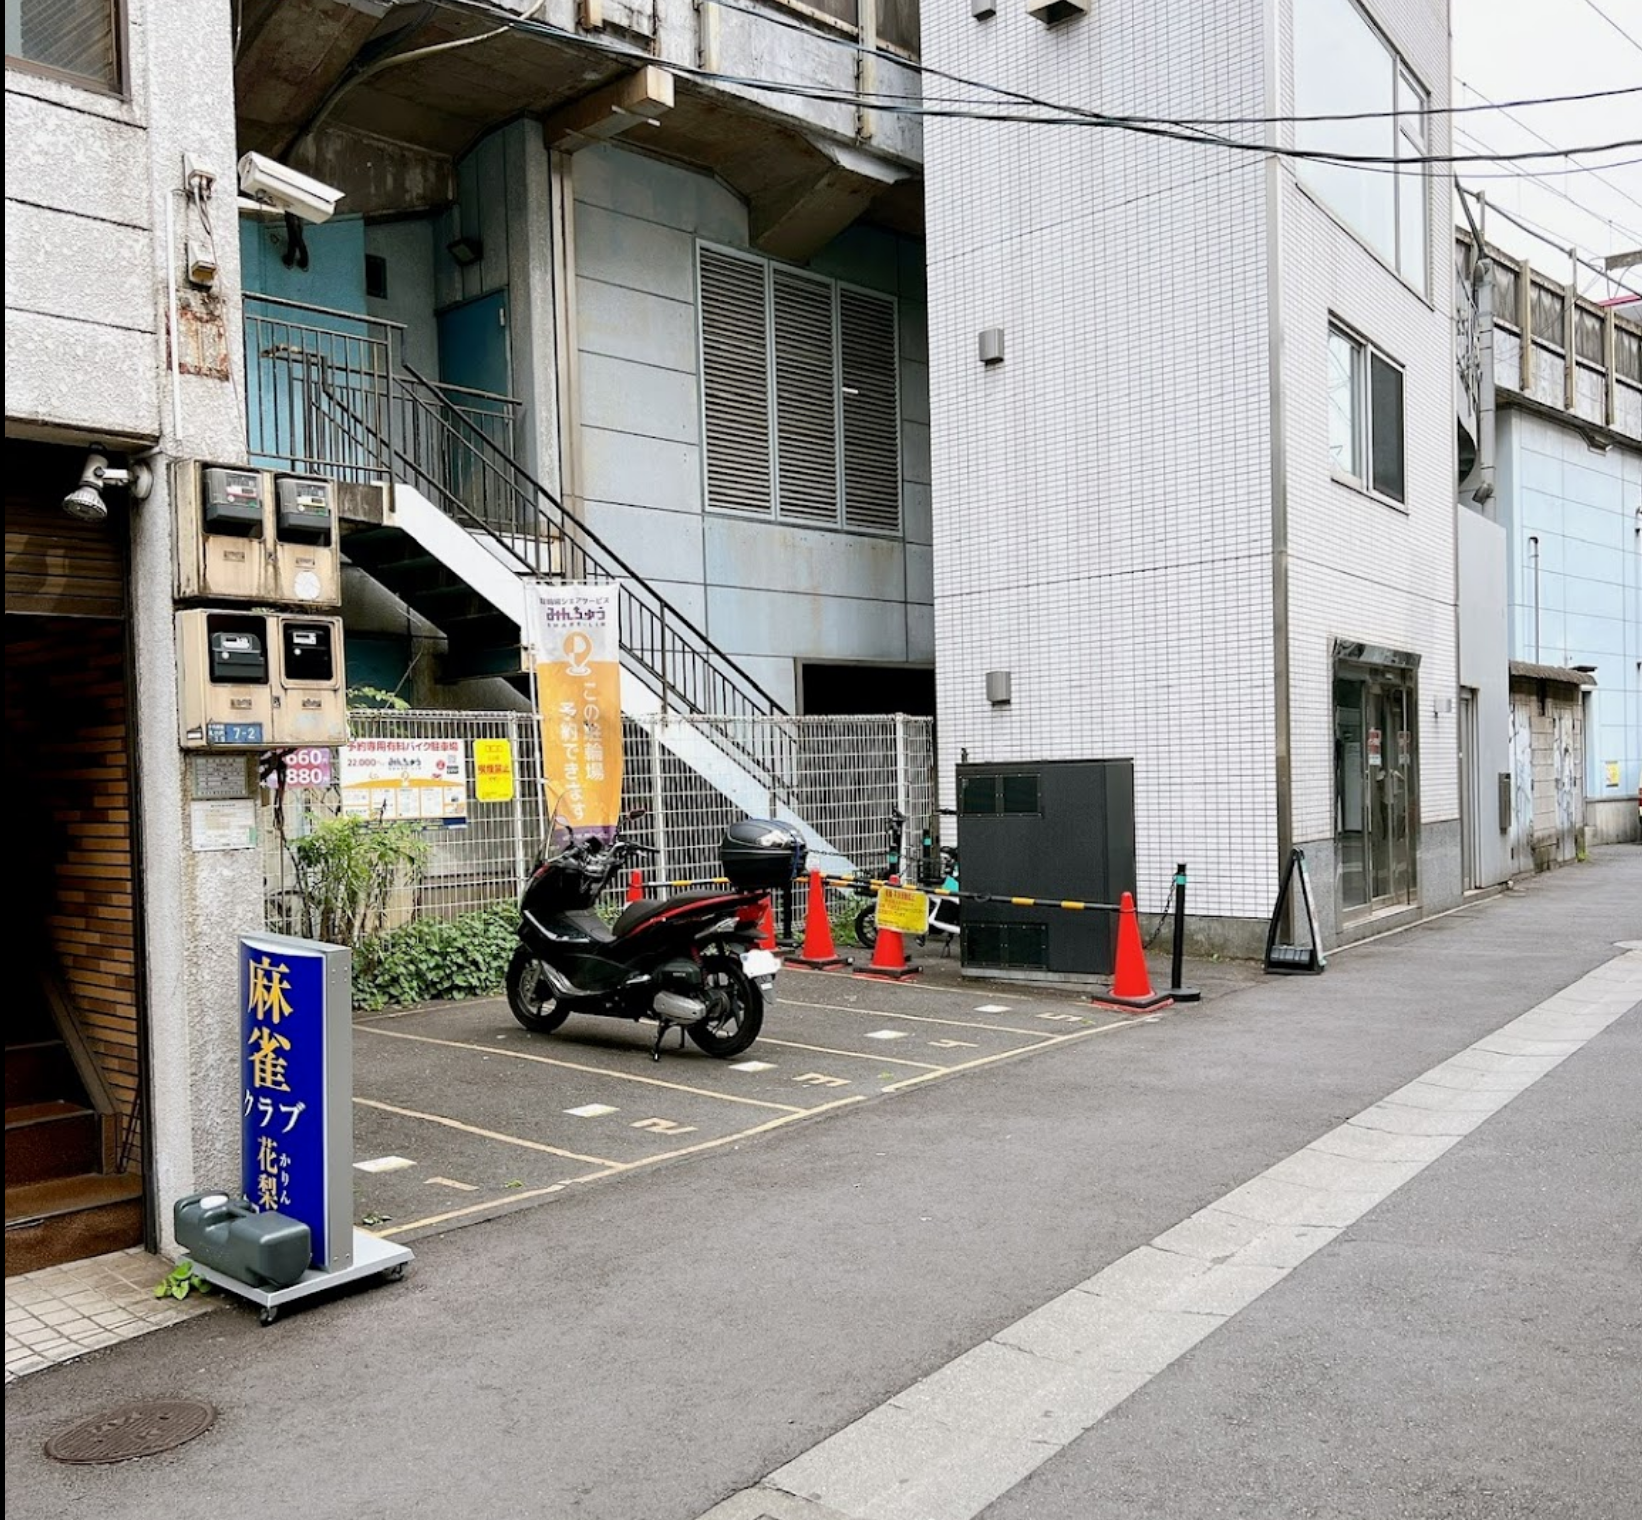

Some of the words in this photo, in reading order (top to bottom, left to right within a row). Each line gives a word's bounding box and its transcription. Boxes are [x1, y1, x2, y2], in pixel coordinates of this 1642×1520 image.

[546, 606, 605, 621] みんちゅう
[233, 727, 256, 739] 7-2
[347, 741, 459, 752] 予約専用有料バイク駐車場
[559, 701, 586, 820] 予約できます
[248, 956, 293, 1092] 麻雀
[1036, 1012, 1083, 1022] 5
[792, 1072, 852, 1088] 3
[244, 1089, 306, 1133] クラブ
[629, 1117, 699, 1135] 2
[257, 1135, 278, 1210] 花梨
[279, 1153, 291, 1205] かりん
[423, 1176, 480, 1191] 1
